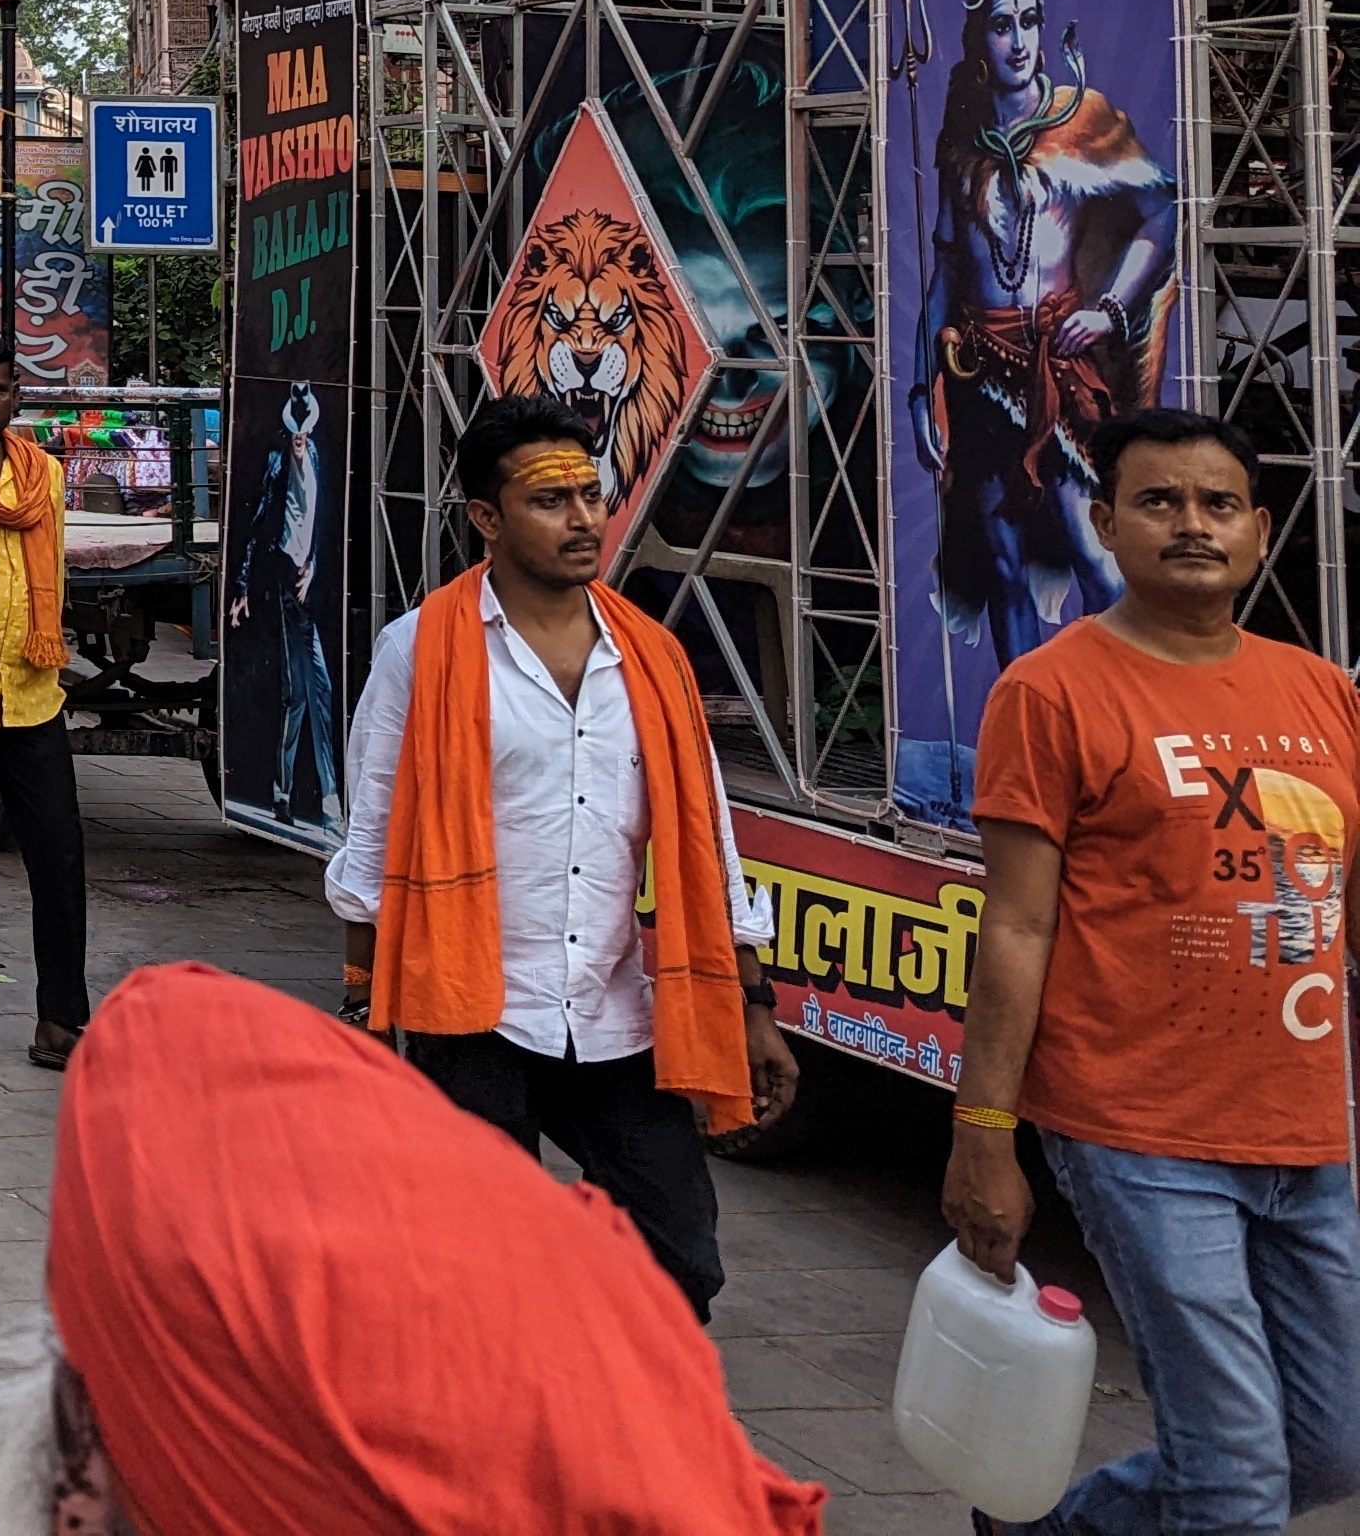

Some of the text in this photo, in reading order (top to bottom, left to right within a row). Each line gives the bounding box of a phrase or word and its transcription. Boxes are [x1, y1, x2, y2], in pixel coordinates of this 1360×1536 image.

[267, 45, 329, 115] MAA
[113, 110, 198, 134] शौचालय
[18, 166, 57, 175] Lehenga
[242, 114, 354, 201] VAISHNO
[123, 204, 188, 219] TOILET
[138, 218, 173, 228] 100 M
[252, 190, 349, 280] BALAJI
[270, 276, 317, 353] D.J.
[802, 993, 943, 1080] प्रो. बालगोविन्द- मो.
